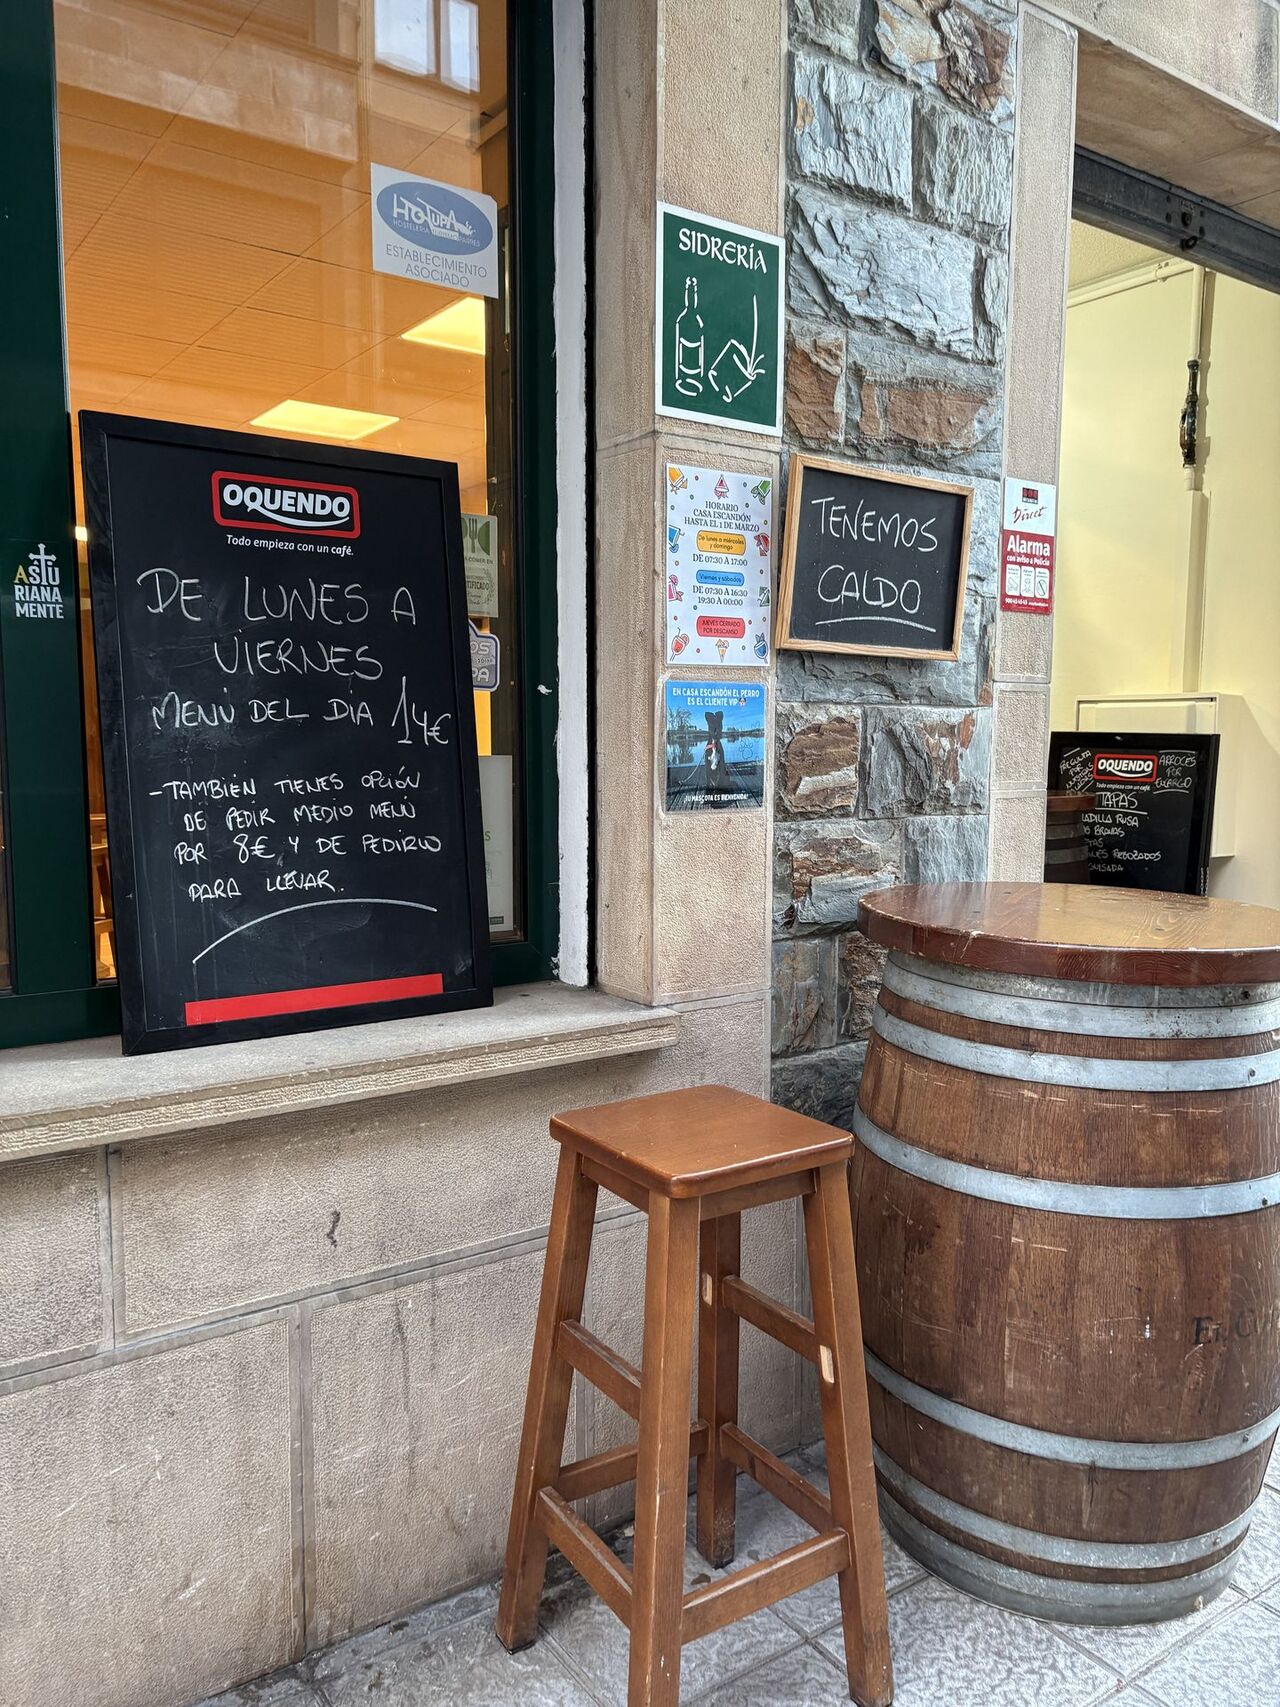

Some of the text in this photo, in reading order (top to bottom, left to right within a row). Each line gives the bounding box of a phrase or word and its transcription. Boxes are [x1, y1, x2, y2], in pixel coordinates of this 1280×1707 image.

[386, 243, 488, 278] ESTABLECIMIENTO
[678, 228, 768, 274] SIDRERÍA
[405, 263, 470, 288] ASOCIADO
[223, 484, 351, 520] OQUENDO
[705, 500, 739, 512] HORARIO
[684, 516, 709, 527] HASTA
[709, 519, 719, 528] EL
[723, 521, 734, 530] DE
[734, 523, 760, 533] MARZO
[693, 508, 752, 523] CASA ESCANDÓN
[811, 496, 938, 553] TENEMOS
[226, 534, 354, 557] Todo empieza con un café.
[713, 543, 734, 551] domingo
[1006, 534, 1051, 557] Alarma
[692, 553, 748, 567] DE 07:30 A 17:00
[14, 584, 63, 603] RIANA
[137, 568, 417, 627] DE LUNES A
[692, 585, 749, 598] DE 07:30 A 16:30
[817, 564, 921, 614] CALDO
[15, 602, 65, 619] MENTE
[697, 596, 744, 607] 19:30 A 00:00
[213, 629, 385, 682] VIERNES
[672, 687, 760, 698] EN CASA ESCANDÓN EL PERRO
[687, 698, 739, 706] ES EL CLIENTE VIP
[249, 699, 310, 724] DEL
[391, 676, 452, 746] 14€
[1097, 759, 1153, 773] OQUENDO
[1166, 766, 1182, 777] POR
[274, 774, 345, 796] TIENES
[1096, 791, 1138, 809] TAPAS
[184, 810, 207, 832] DE
[226, 801, 276, 831] PEDIR
[293, 798, 353, 824] MEDIO
[1115, 813, 1139, 828] RUSA
[173, 842, 209, 865] POR
[232, 833, 276, 864] 8€
[316, 835, 347, 855] DE
[188, 877, 243, 903] PARA
